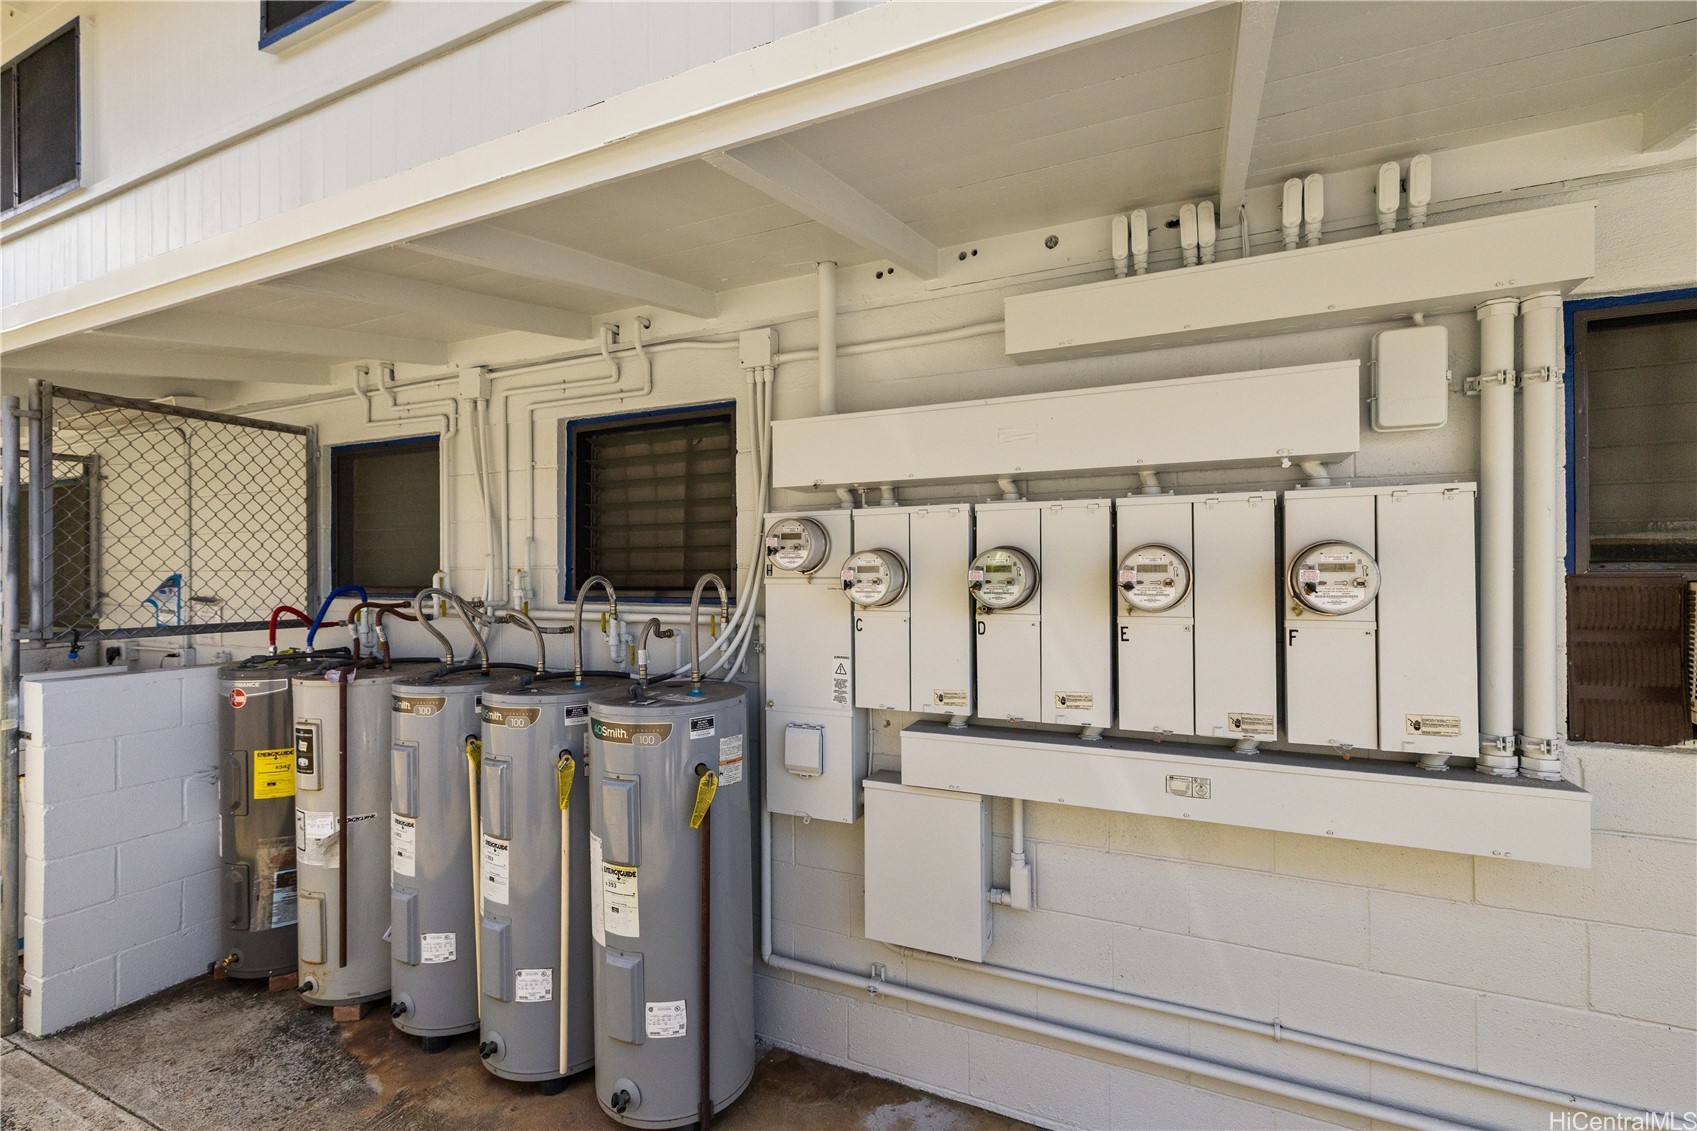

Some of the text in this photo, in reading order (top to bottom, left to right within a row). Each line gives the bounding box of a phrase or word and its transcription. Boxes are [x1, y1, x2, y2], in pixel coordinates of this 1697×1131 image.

[766, 564, 773, 577] H
[856, 618, 863, 632] C
[978, 621, 986, 635] D
[1120, 626, 1130, 642] E
[1288, 629, 1299, 647] F
[418, 707, 431, 715] 100
[511, 718, 525, 727] 100
[639, 735, 655, 745] 100
[604, 866, 637, 878] ENERGYGUIDE
